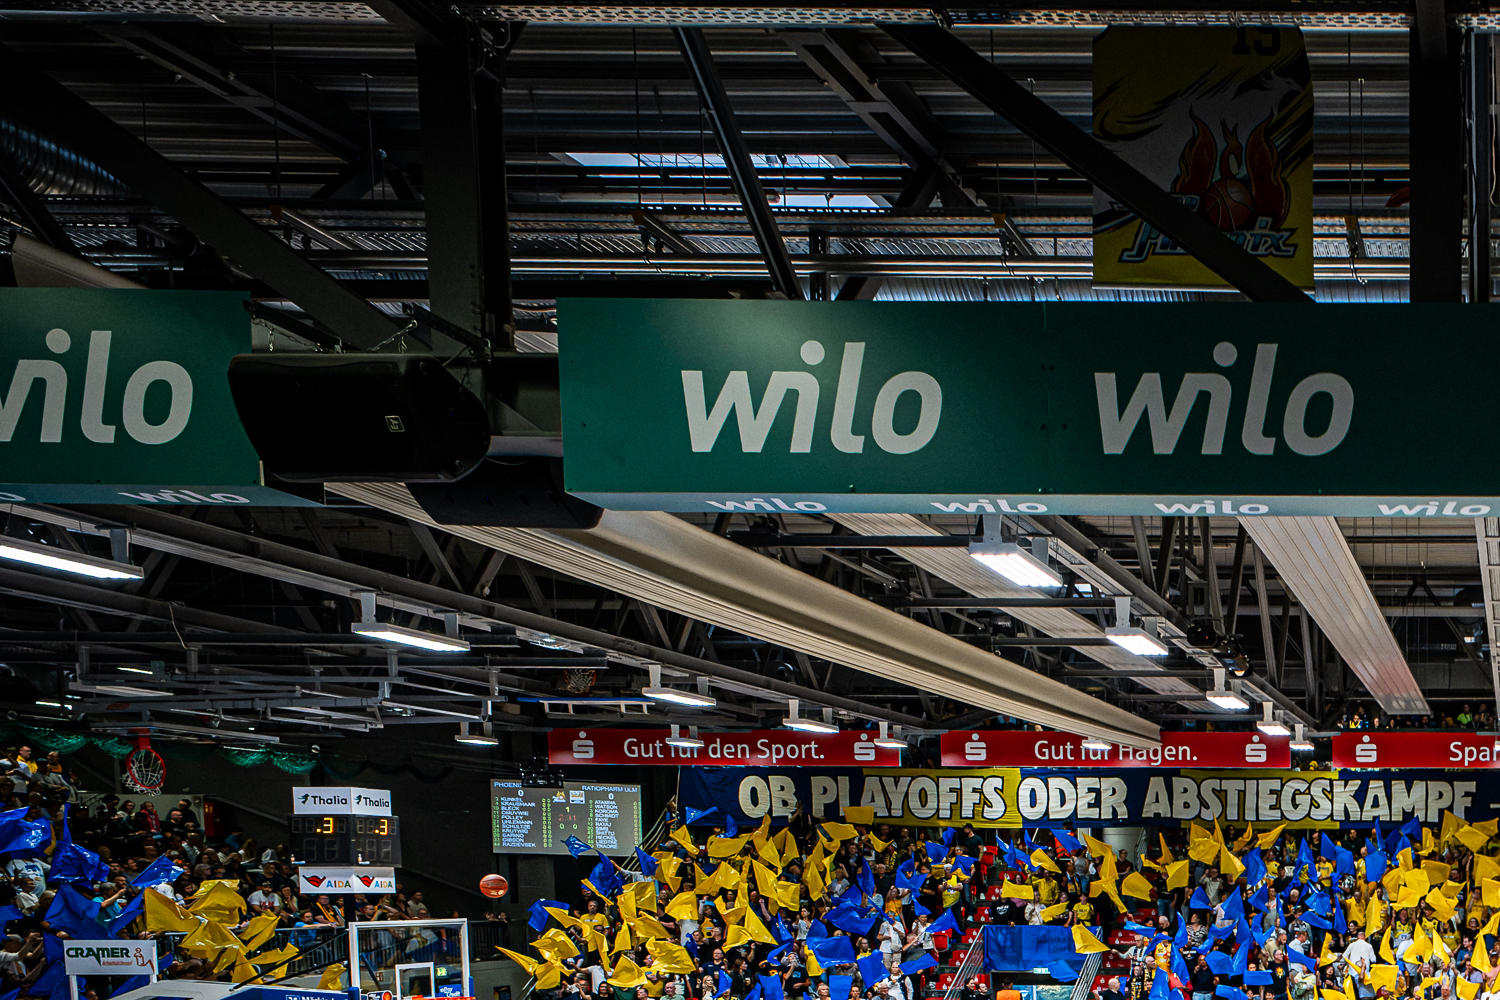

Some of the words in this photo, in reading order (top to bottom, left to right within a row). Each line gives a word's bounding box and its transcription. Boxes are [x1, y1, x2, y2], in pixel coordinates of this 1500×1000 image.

[681, 340, 942, 454] wilo
[1094, 341, 1354, 456] wilo
[117, 489, 250, 503] wilo
[705, 497, 827, 513] wilo
[930, 498, 1048, 514] wilo
[1153, 499, 1270, 515] wilo
[1378, 500, 1491, 516] wilo
[623, 738, 663, 758] Gut
[708, 738, 750, 758] den
[757, 739, 825, 763] Sport.
[1034, 740, 1075, 760] Gut
[1120, 741, 1198, 765] Hagen.
[311, 795, 347, 805] Thalia
[518, 789, 524, 797] 0
[738, 775, 797, 819] OB
[811, 775, 1005, 820] PLAYOFFS
[1019, 777, 1128, 820] ODER
[1141, 777, 1476, 823] ABSTIEGSKAMPF
[363, 797, 390, 808] Thalia
[326, 880, 352, 888] AIDA
[374, 880, 393, 888] AIDA
[66, 947, 131, 965] CRAMER
